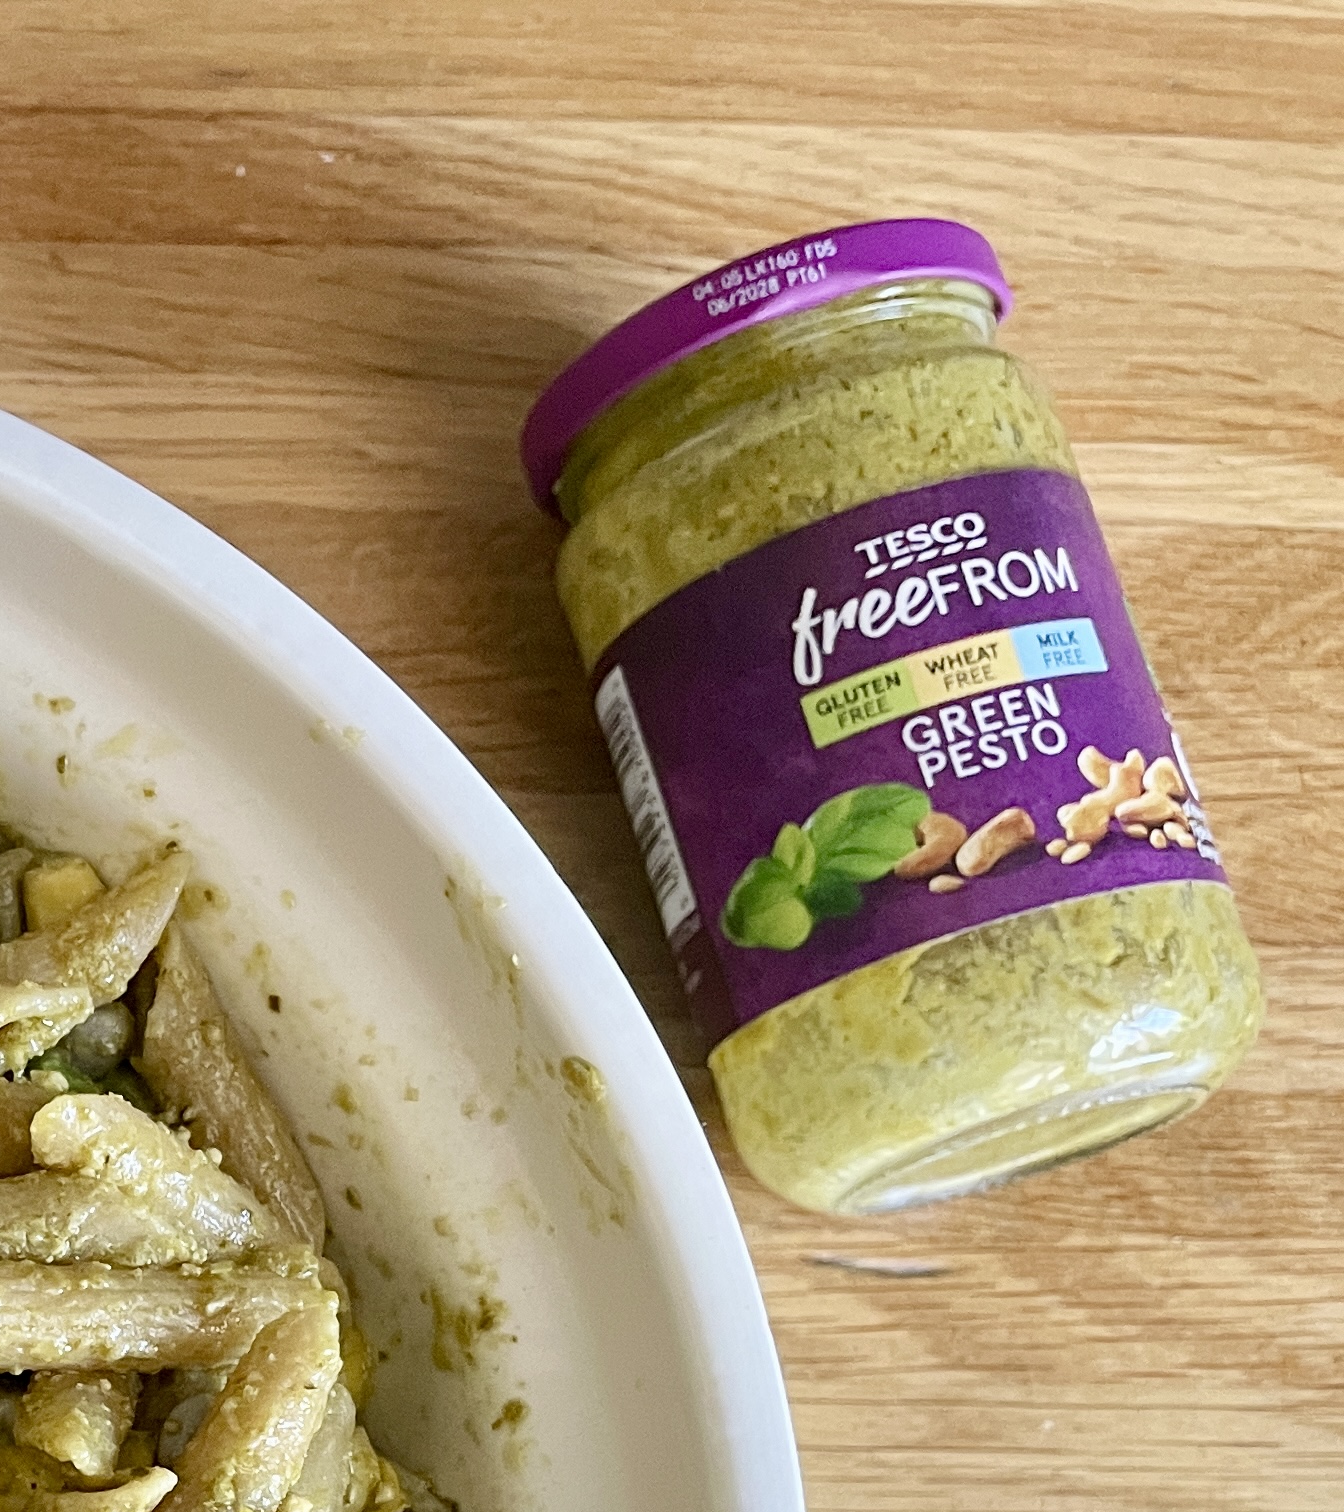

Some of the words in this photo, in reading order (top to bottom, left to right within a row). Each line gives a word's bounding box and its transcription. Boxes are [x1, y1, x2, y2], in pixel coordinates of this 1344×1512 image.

[707, 275, 780, 316] 06/2028
[854, 512, 987, 566] TESCO
[792, 547, 1080, 686] freeFROM
[924, 642, 1000, 676] WHEAT
[1036, 630, 1080, 650] MILK
[1042, 648, 1087, 669] FREE
[815, 671, 902, 718] GLUTEN
[942, 664, 997, 693] FREE
[837, 695, 891, 731] FREE
[901, 682, 1061, 754] GREEN
[917, 719, 1069, 789] PESTO
